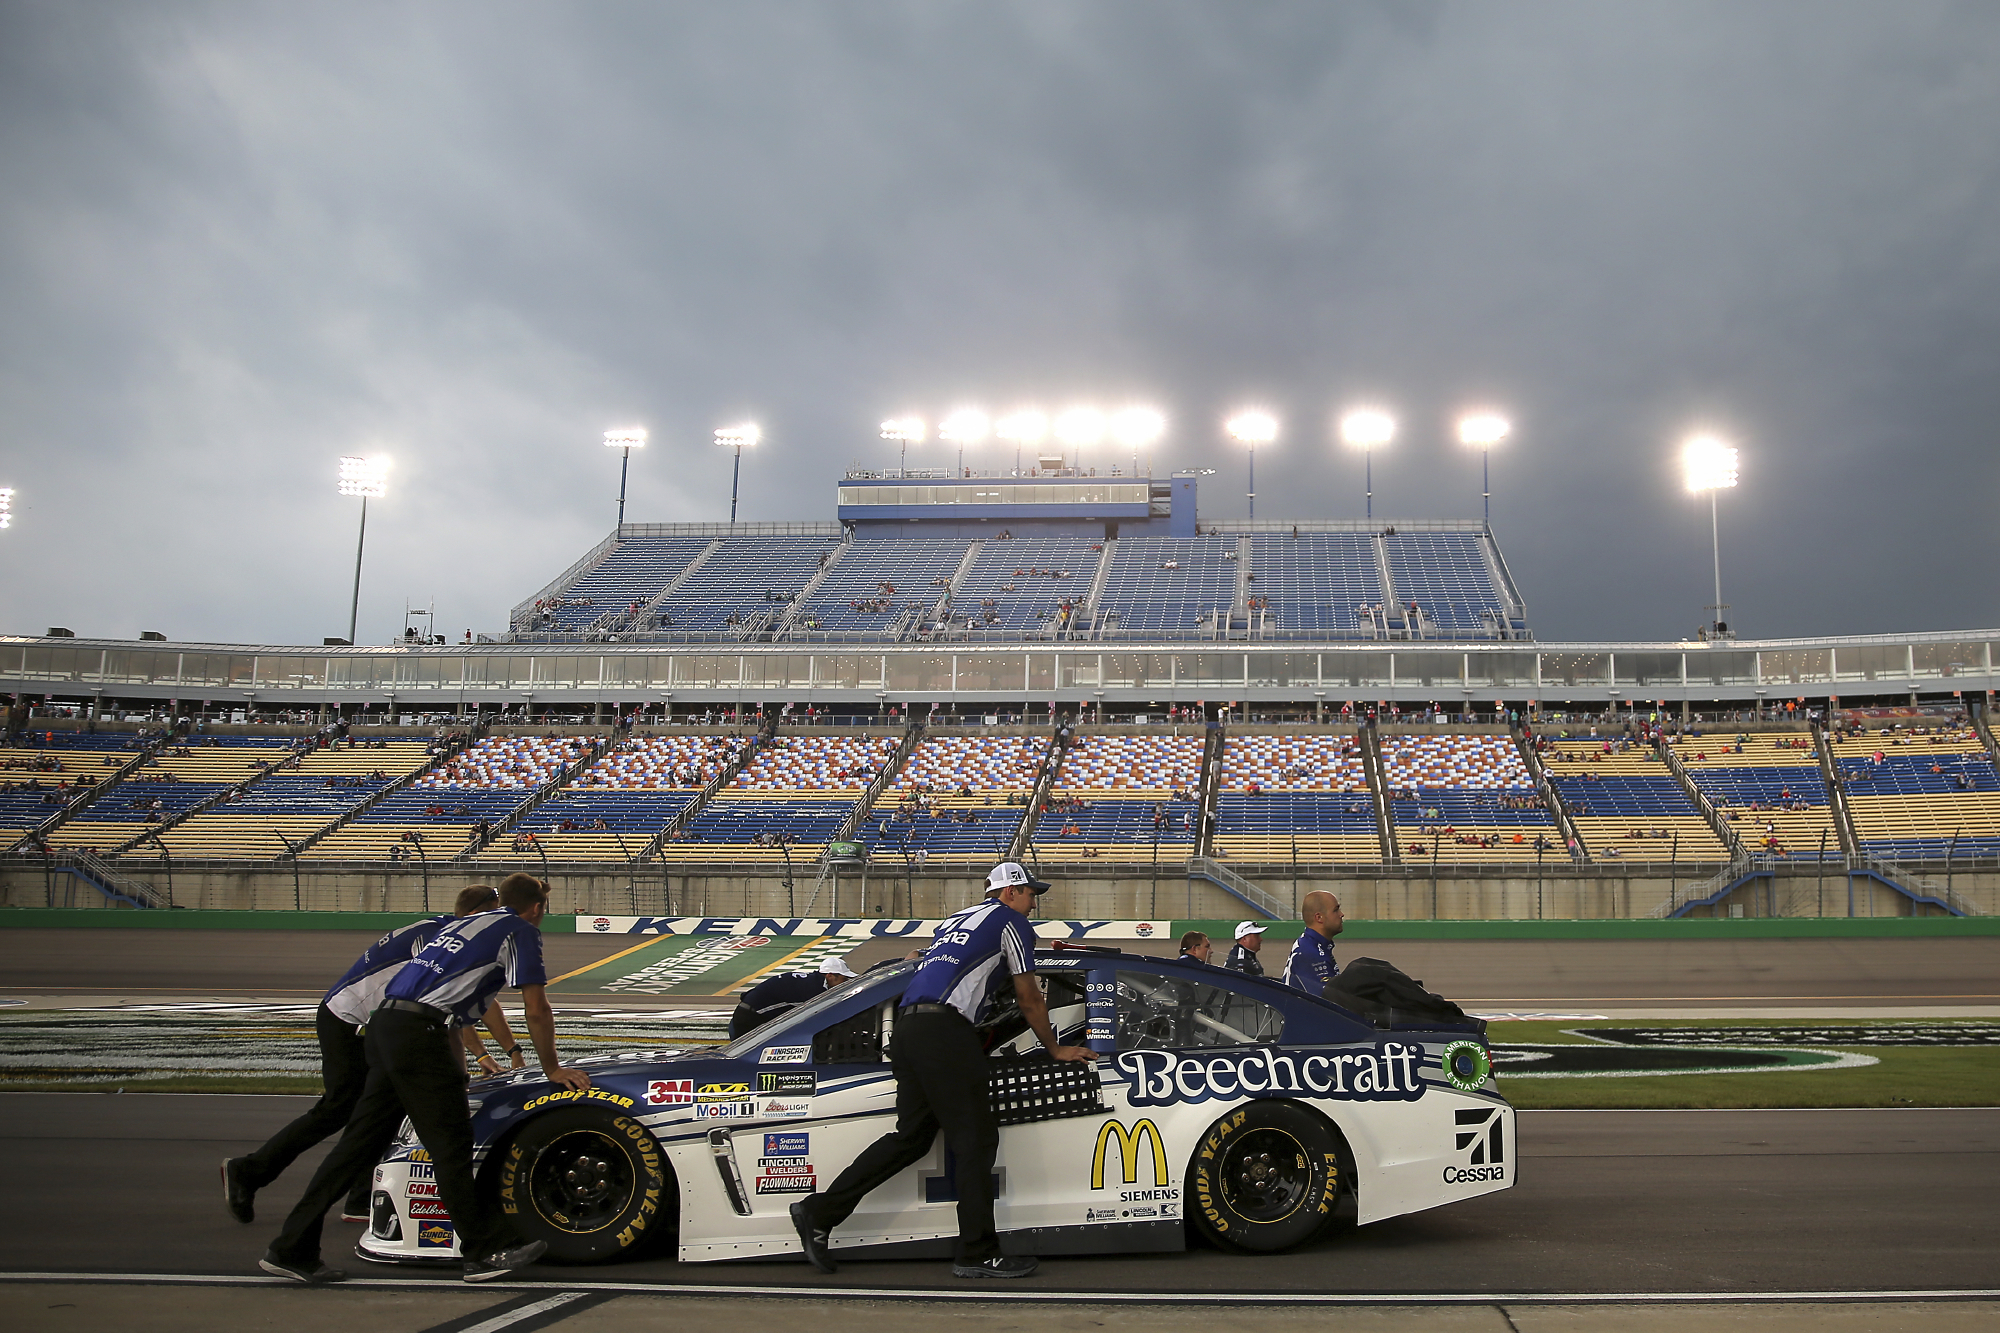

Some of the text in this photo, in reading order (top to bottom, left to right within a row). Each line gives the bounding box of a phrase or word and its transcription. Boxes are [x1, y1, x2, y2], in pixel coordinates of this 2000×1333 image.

[628, 917, 1112, 938] KENTUY
[600, 948, 707, 993] SPEEDWAY
[625, 948, 744, 994] KENTUCKY
[1034, 958, 1081, 967] cMurray
[1444, 1041, 1487, 1060] AMERICAN
[1118, 1043, 1420, 1099] Beechcraft
[1447, 1072, 1488, 1091] ETHANOL
[650, 1080, 692, 1104] 3M
[697, 1103, 737, 1117] Mobil
[766, 1103, 789, 1112] Coors
[410, 1164, 434, 1178] MA
[760, 1158, 804, 1167] LINCOLN
[502, 1143, 524, 1214] EAGLE
[1316, 1153, 1339, 1214] EAGLE
[1442, 1166, 1504, 1184] Cessna
[408, 1184, 440, 1195] COM
[758, 1176, 813, 1192] FLOWMASTER
[1120, 1189, 1179, 1202] SIEMENS
[410, 1202, 449, 1215] Edelbroc
[420, 1231, 453, 1239] SUNOCO
